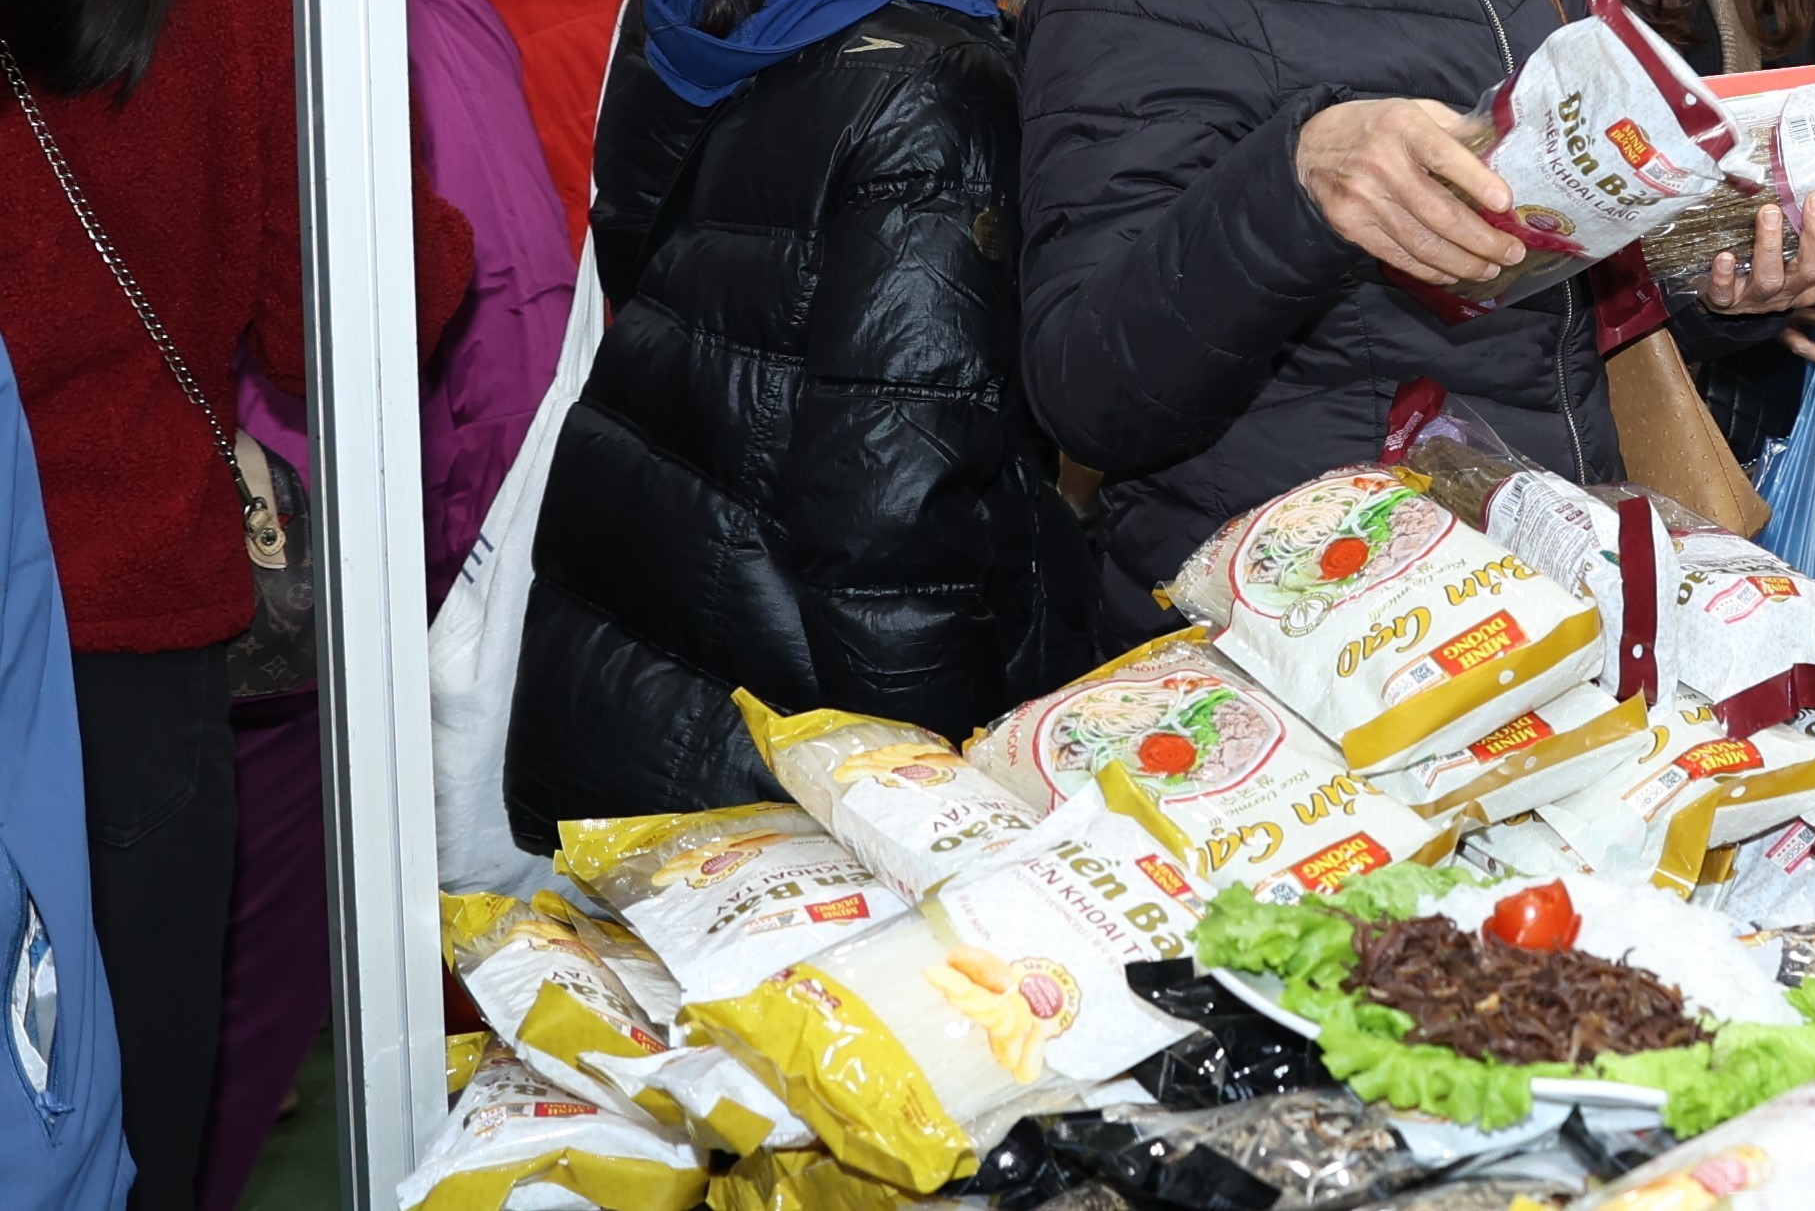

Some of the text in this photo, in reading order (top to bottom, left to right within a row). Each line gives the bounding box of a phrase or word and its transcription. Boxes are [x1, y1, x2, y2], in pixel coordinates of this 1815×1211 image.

[1557, 90, 1660, 208] Điền Bảo
[1610, 129, 1641, 165] DƯƠNG
[1622, 123, 1648, 153] MINH
[1549, 156, 1596, 202] KHOAI
[1594, 199, 1640, 223] LANG
[1336, 554, 1541, 678] Bún Gạo
[1442, 617, 1508, 661] DƯƠNG
[1457, 631, 1512, 670] MINH
[1006, 722, 1022, 768] NGON
[1486, 726, 1538, 755] MINH
[762, 865, 841, 885] KHOAI
[1302, 838, 1370, 880] DƯƠNG
[706, 880, 804, 935] Bảo
[821, 907, 859, 920] MINH
[1058, 885, 1126, 944] KHOAI
